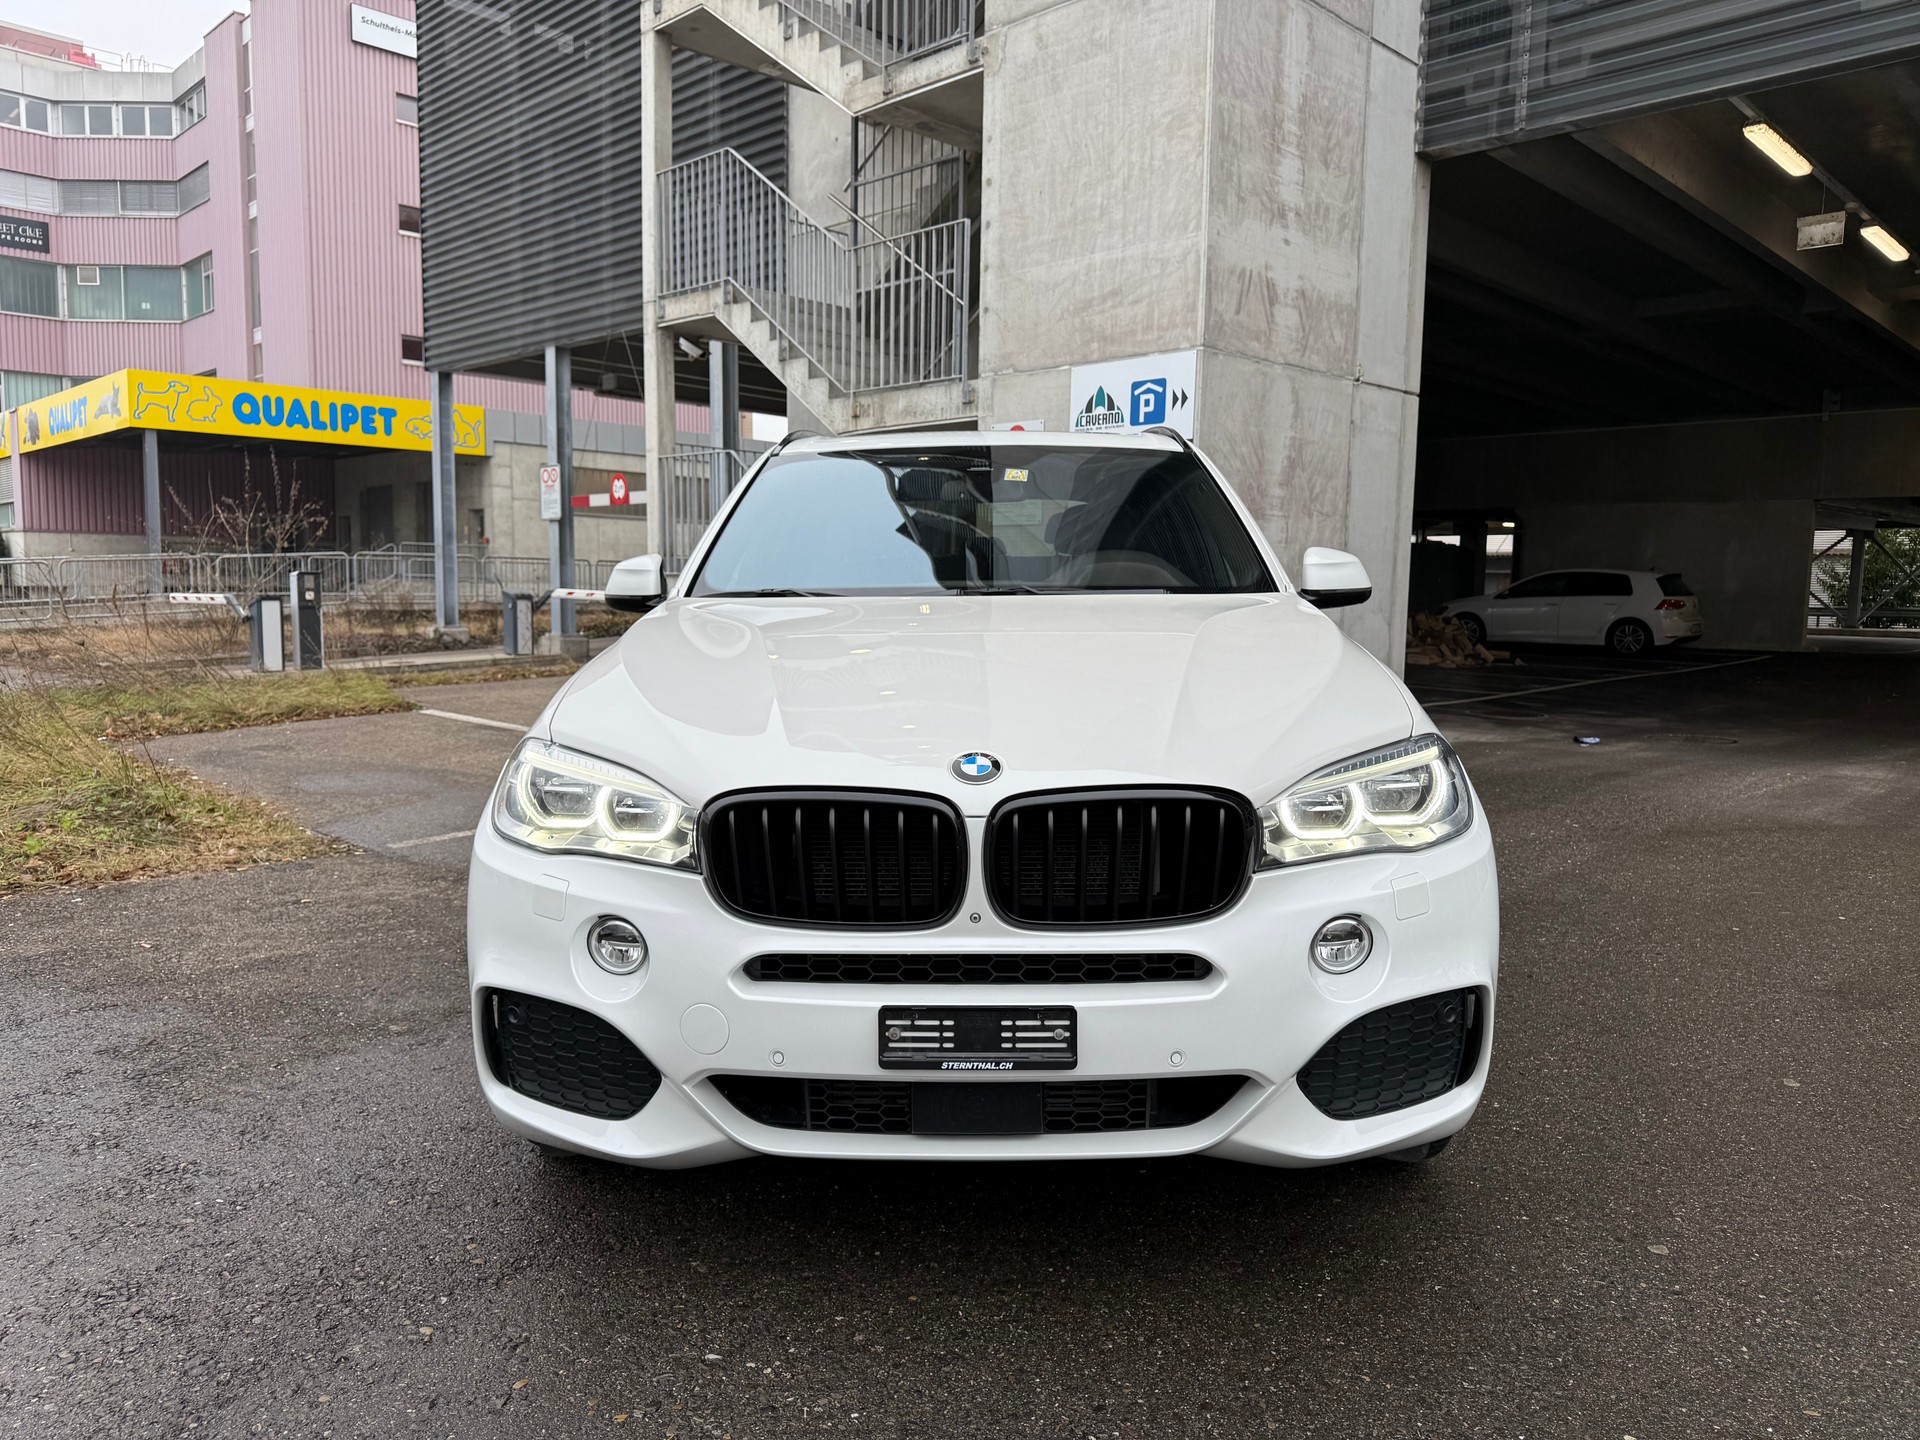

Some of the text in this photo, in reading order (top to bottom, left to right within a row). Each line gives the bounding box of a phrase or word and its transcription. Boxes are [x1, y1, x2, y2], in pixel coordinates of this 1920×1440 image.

[14, 236, 43, 246] ROOMS
[48, 396, 88, 436] QUALIPET
[232, 392, 397, 437] QUALIPET
[1079, 411, 1121, 428] CAVERNO
[1139, 393, 1155, 423] P
[941, 1061, 1014, 1070] STERNTHAL.CH
